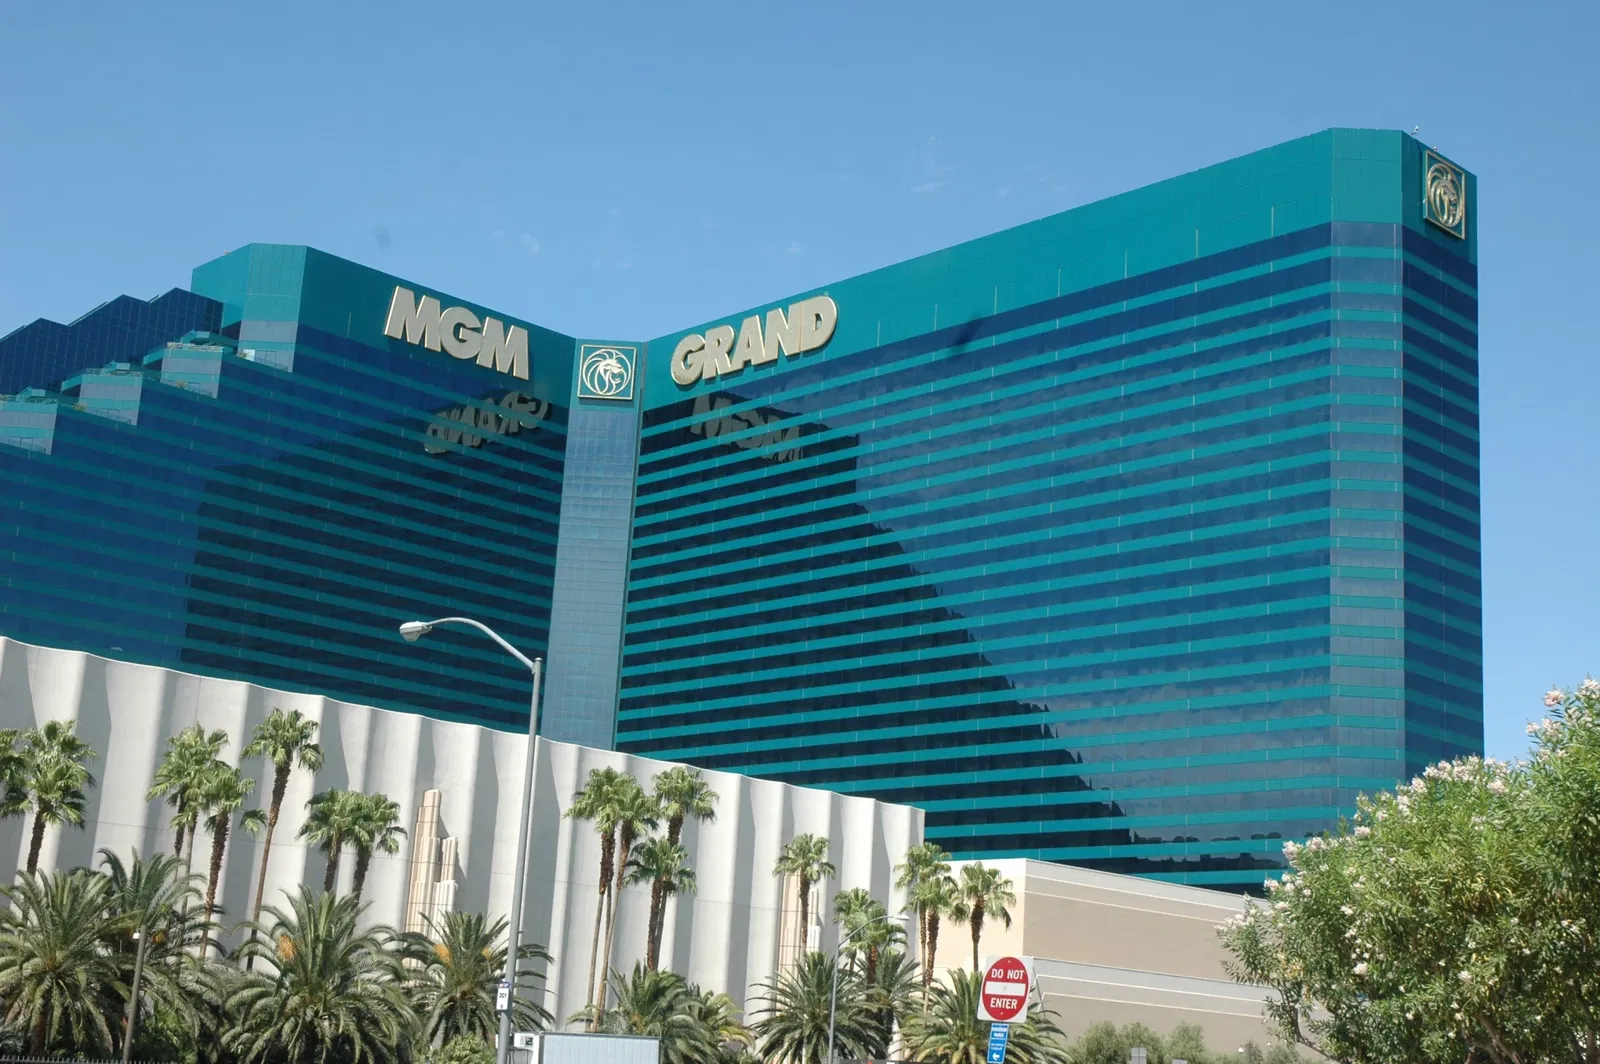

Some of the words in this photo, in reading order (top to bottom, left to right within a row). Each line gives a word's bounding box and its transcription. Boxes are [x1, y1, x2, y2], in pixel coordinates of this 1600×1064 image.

[384, 285, 530, 380] MGM
[671, 296, 838, 385] GRAND
[991, 968, 1004, 978] DO
[1007, 969, 1025, 980] NOT
[990, 997, 1018, 1009] ENTER
